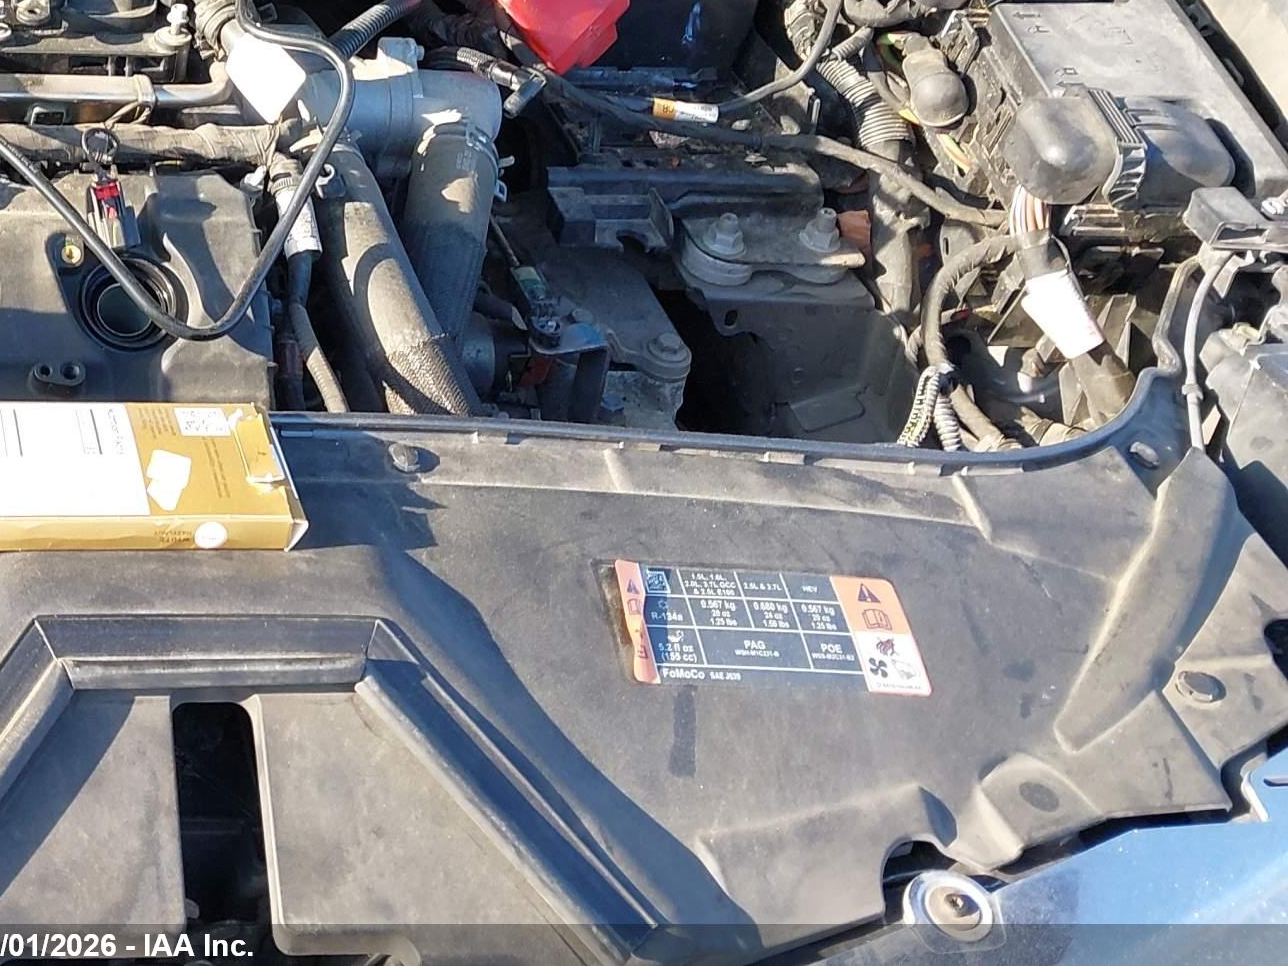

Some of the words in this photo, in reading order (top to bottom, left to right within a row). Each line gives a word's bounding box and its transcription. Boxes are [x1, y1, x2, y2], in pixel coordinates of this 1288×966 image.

[723, 600, 736, 612] kg
[775, 602, 788, 614] kg
[823, 605, 836, 616] kg
[650, 611, 684, 622] R-134a
[658, 642, 673, 652] 5.2
[682, 644, 694, 653] oz
[743, 639, 766, 650] PAG
[820, 643, 843, 654] POE
[662, 668, 705, 680] FoMoCo
